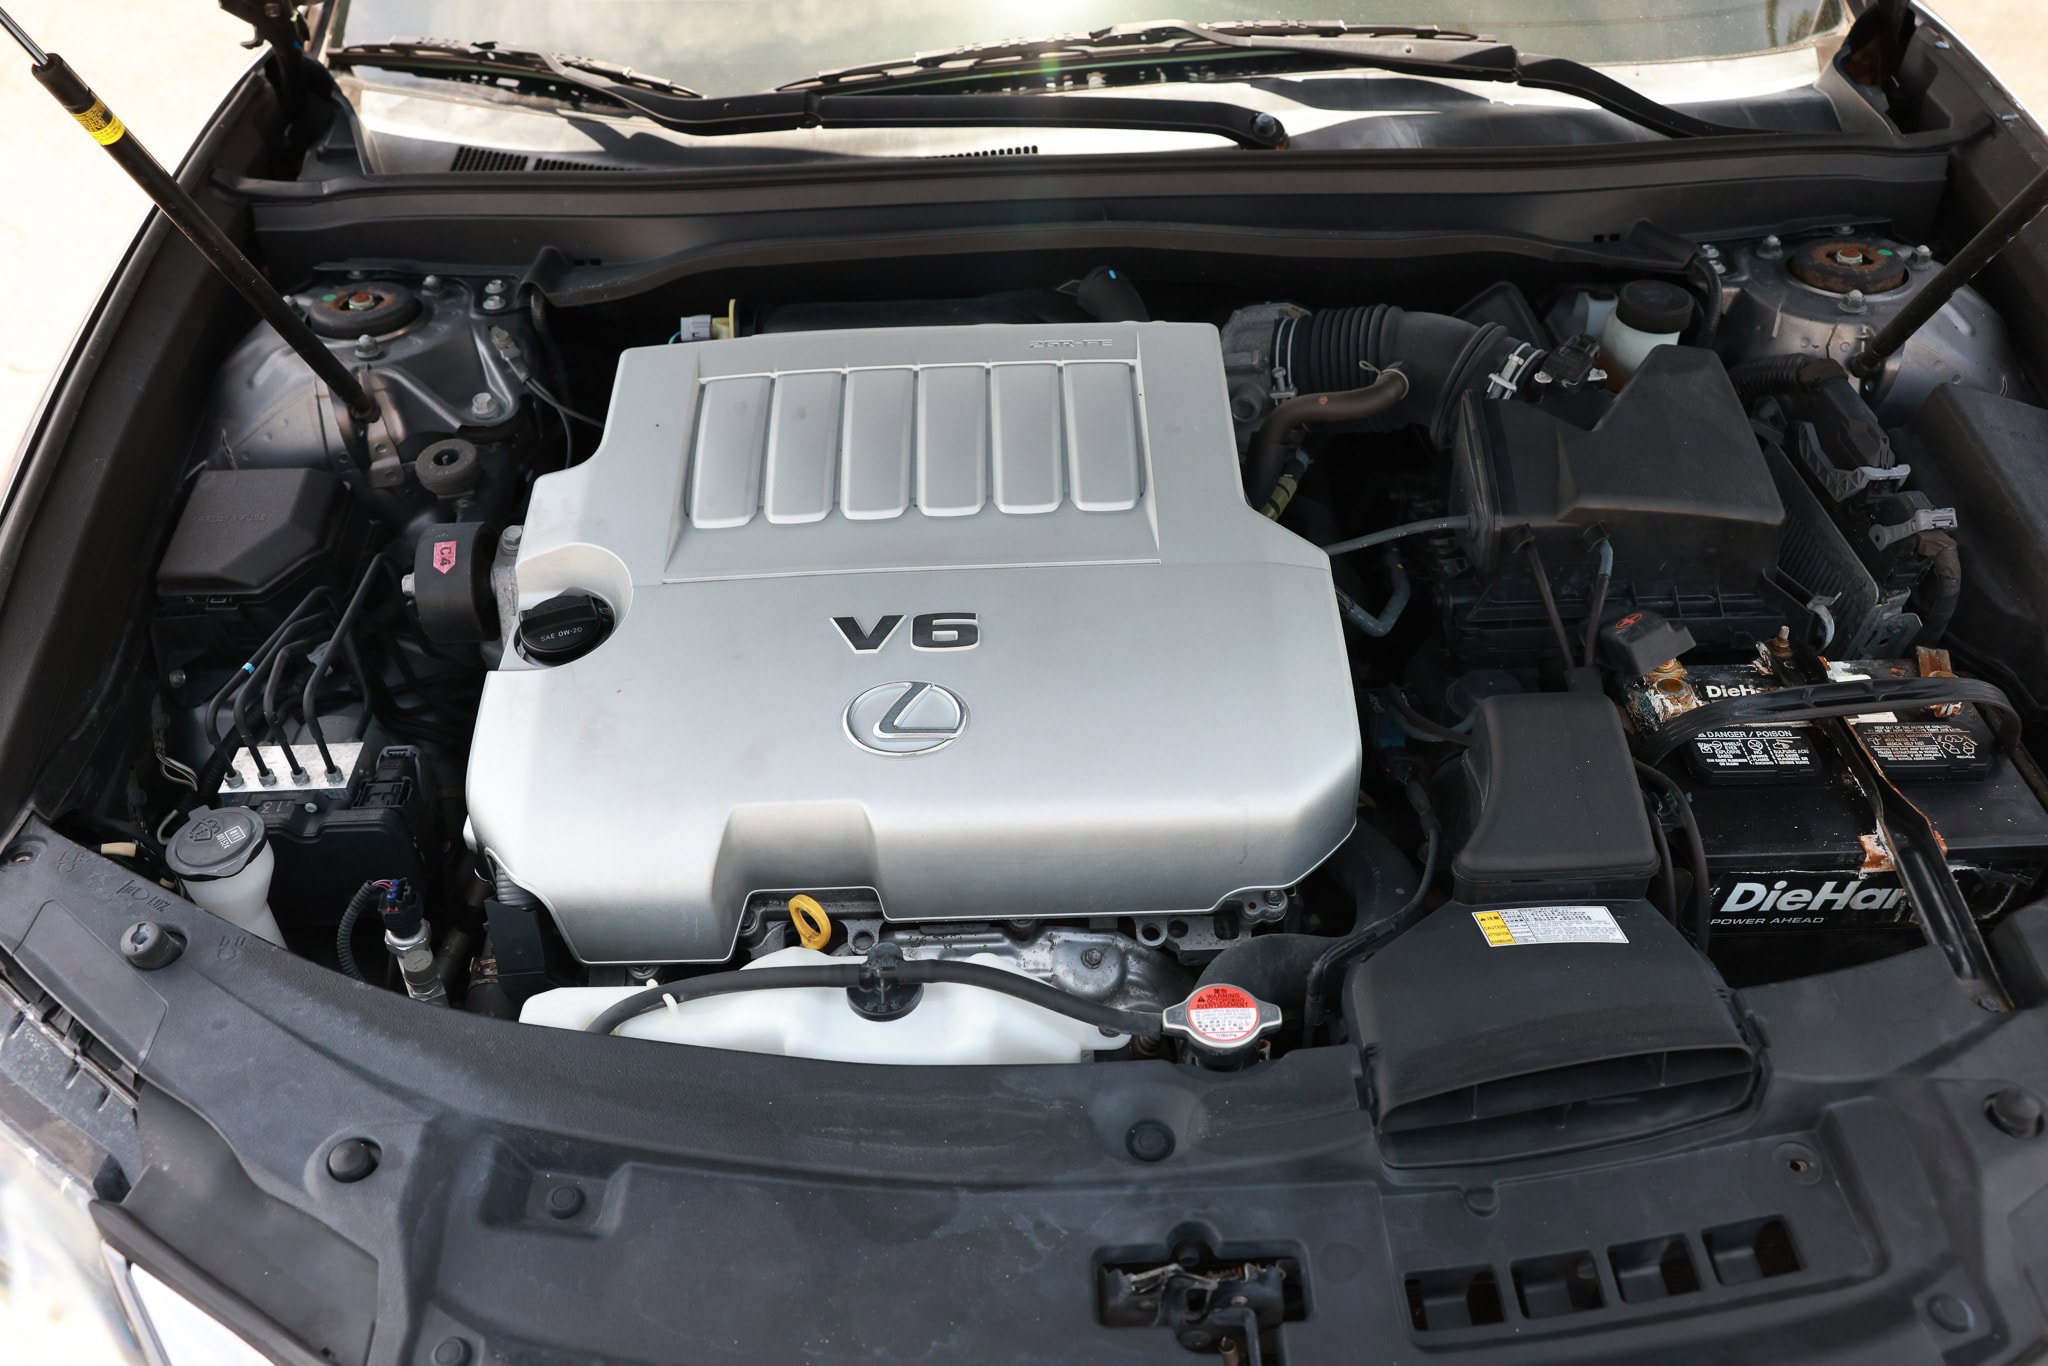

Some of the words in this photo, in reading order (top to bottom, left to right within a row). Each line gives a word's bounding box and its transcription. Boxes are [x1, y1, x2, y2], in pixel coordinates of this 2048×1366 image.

[540, 630, 555, 642] SAE
[558, 626, 583, 638] 0W-20
[829, 611, 980, 655] V6
[1719, 880, 1906, 913] DieHar
[1710, 917, 1766, 926] POWER
[1769, 916, 1824, 925] AHEAD
